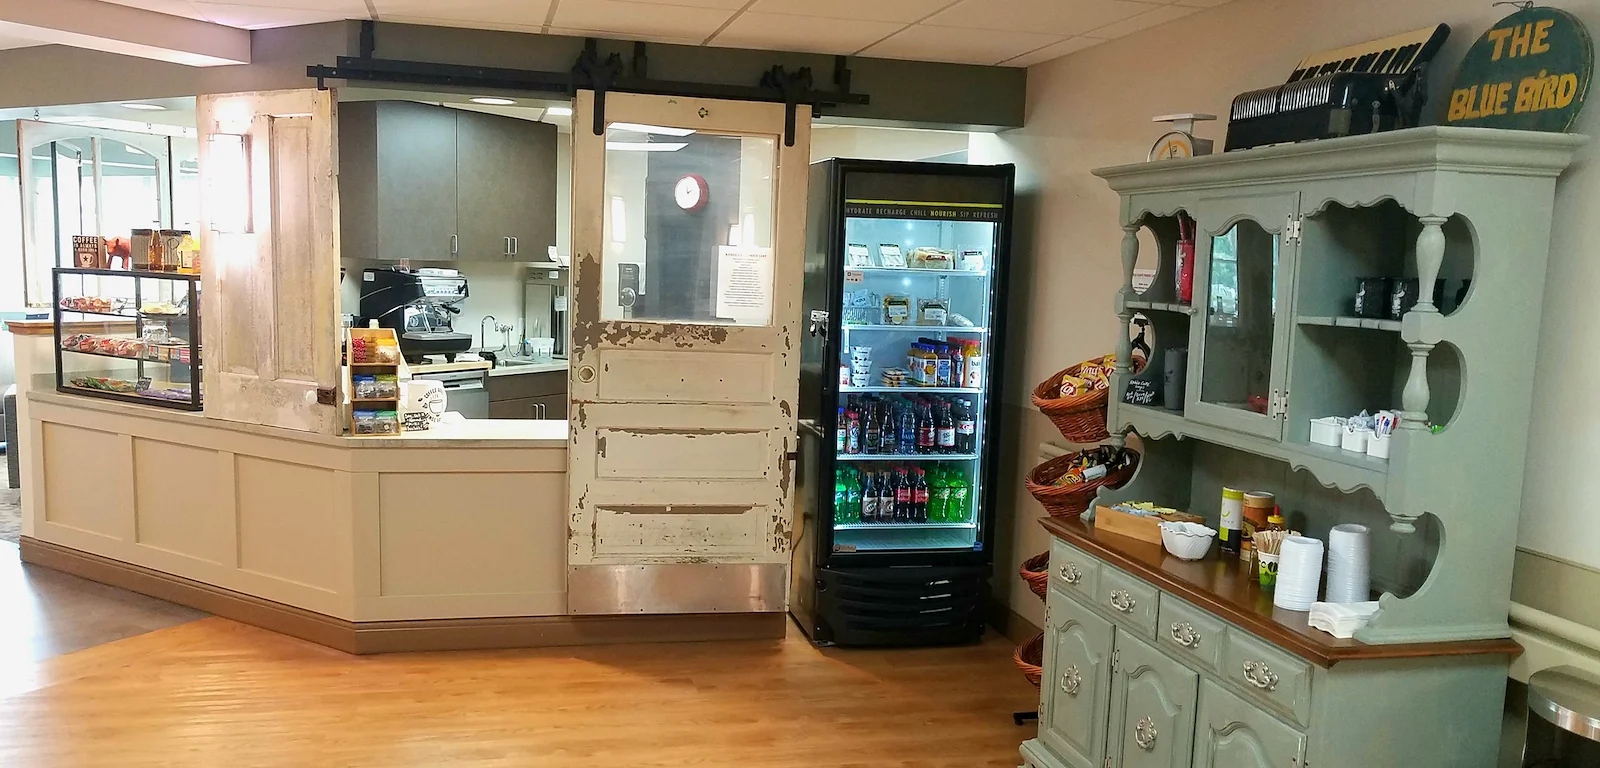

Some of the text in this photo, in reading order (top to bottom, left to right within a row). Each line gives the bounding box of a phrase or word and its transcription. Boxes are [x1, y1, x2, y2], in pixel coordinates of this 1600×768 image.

[1487, 19, 1554, 62] THE
[1447, 80, 1512, 122] BLUE
[846, 207, 872, 215] HYDRATE
[876, 208, 906, 216] RECHARGE
[930, 209, 957, 217] NOURISH
[973, 211, 998, 219] REFRESH
[73, 236, 98, 244] COFFEE
